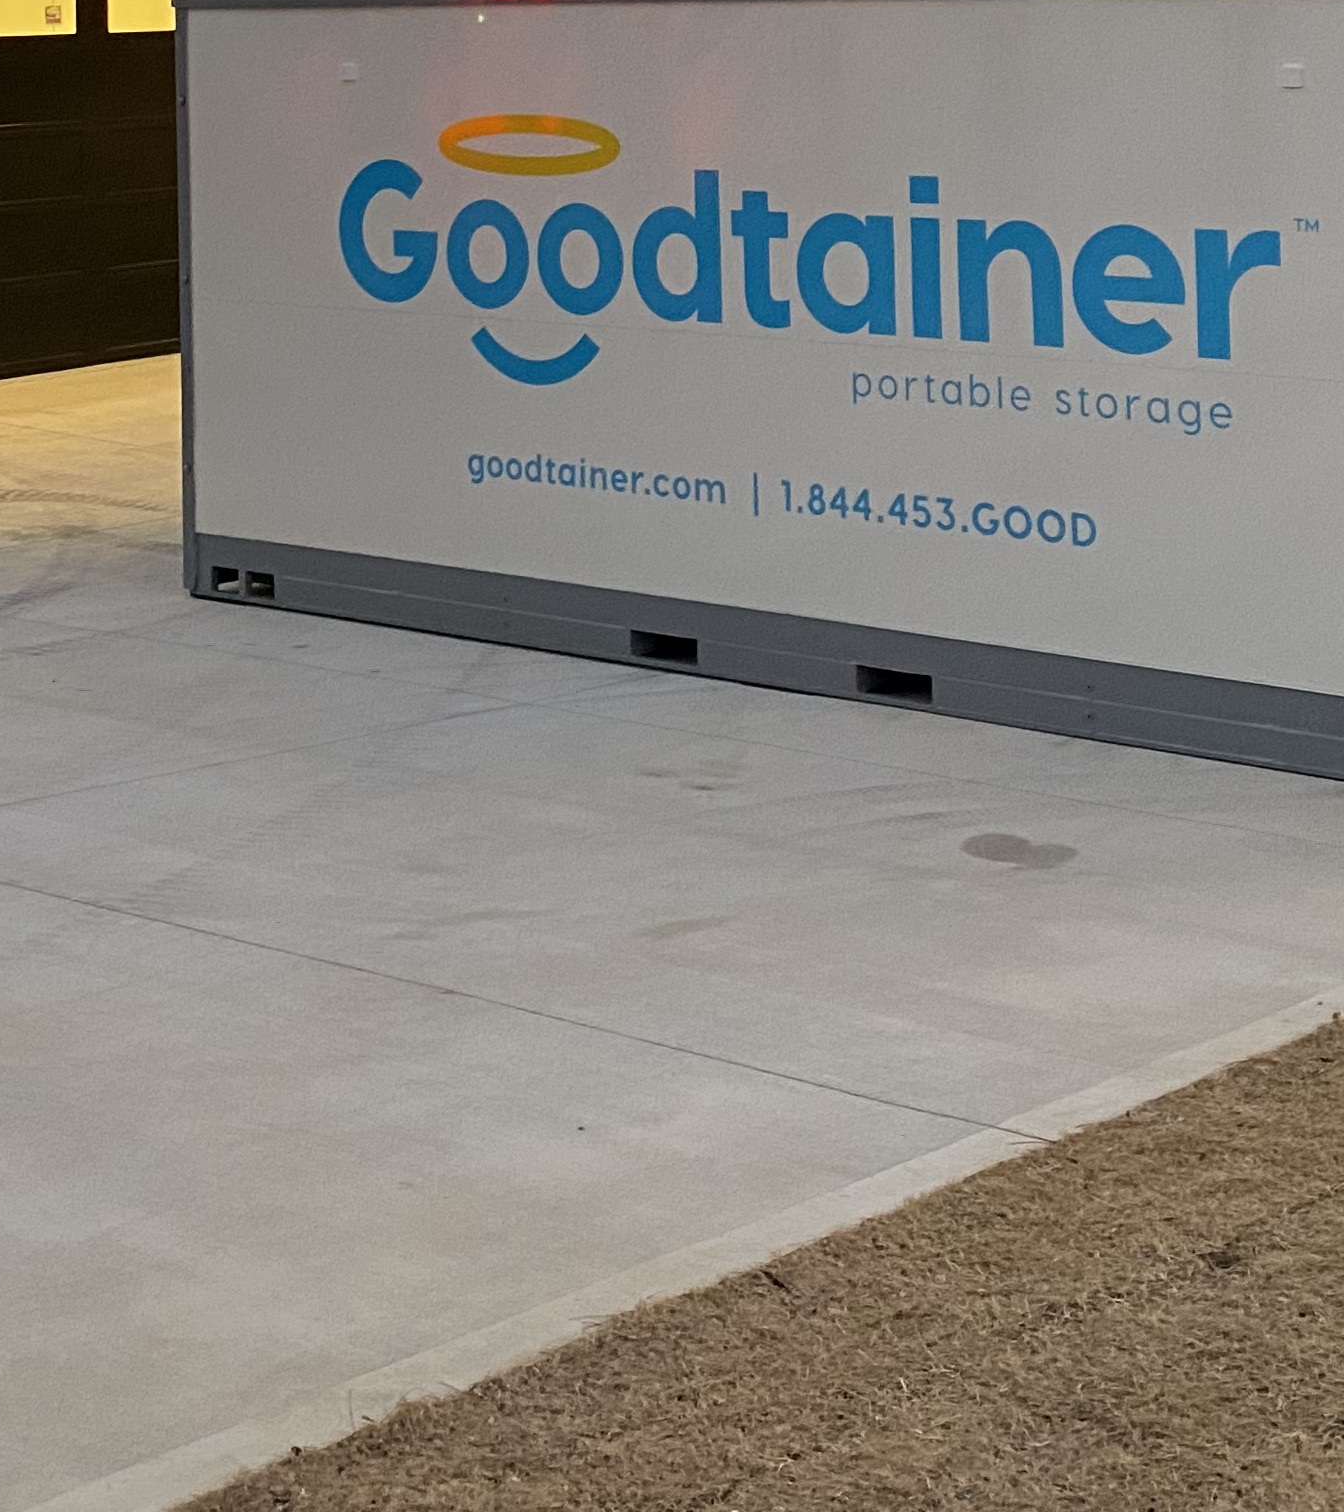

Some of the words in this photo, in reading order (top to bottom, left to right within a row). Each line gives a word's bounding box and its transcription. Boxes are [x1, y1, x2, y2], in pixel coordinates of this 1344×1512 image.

[339, 159, 1281, 360] Goodtainer
[852, 371, 1032, 411] portable
[1055, 387, 1234, 436] storage
[467, 453, 726, 505] goodtainer.com
[780, 479, 1098, 548] 1.844.453.GOOD
